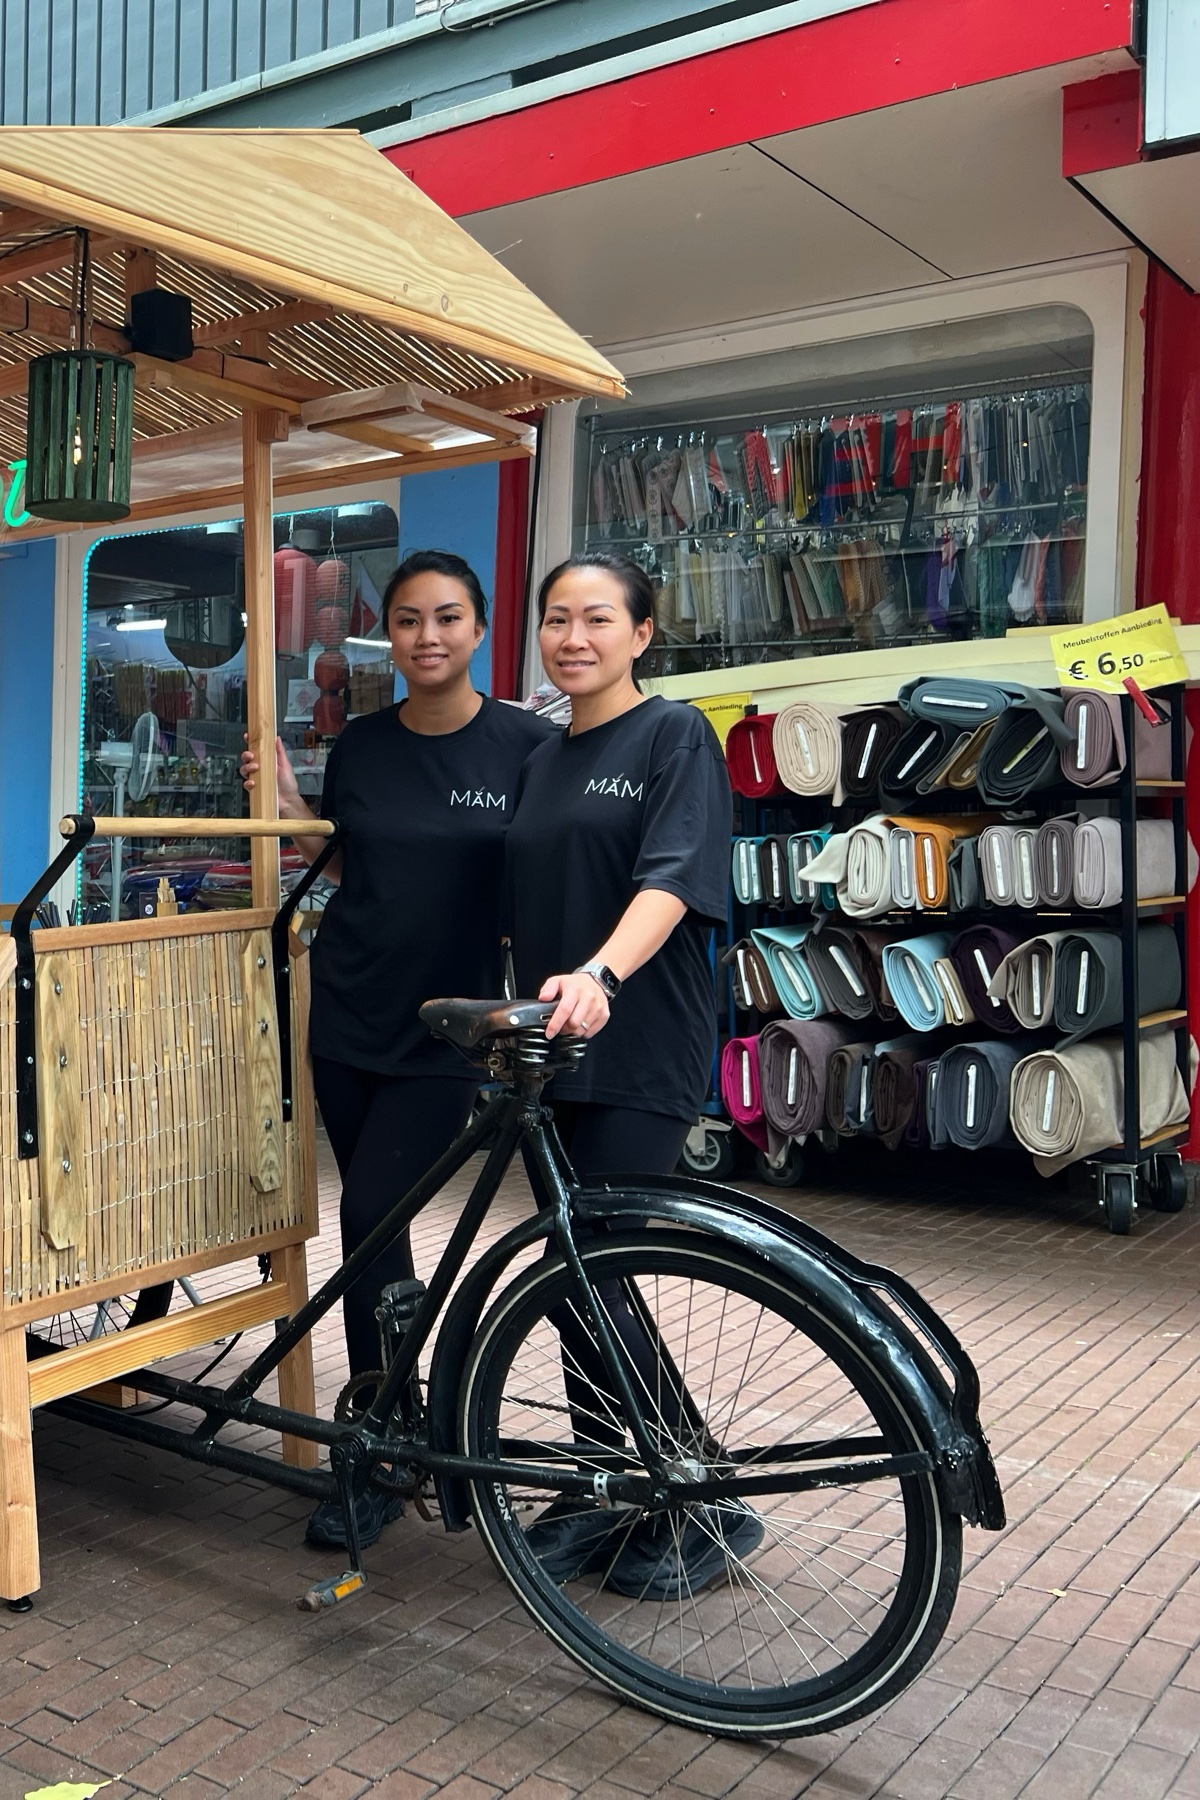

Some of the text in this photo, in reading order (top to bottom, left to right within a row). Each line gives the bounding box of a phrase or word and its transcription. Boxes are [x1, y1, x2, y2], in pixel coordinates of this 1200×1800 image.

[1063, 617, 1163, 649] Meubelstoffen Aanbieding
[1068, 660, 1089, 680] €
[1097, 652, 1144, 675] 6,50
[708, 704, 743, 713] Aanbieding
